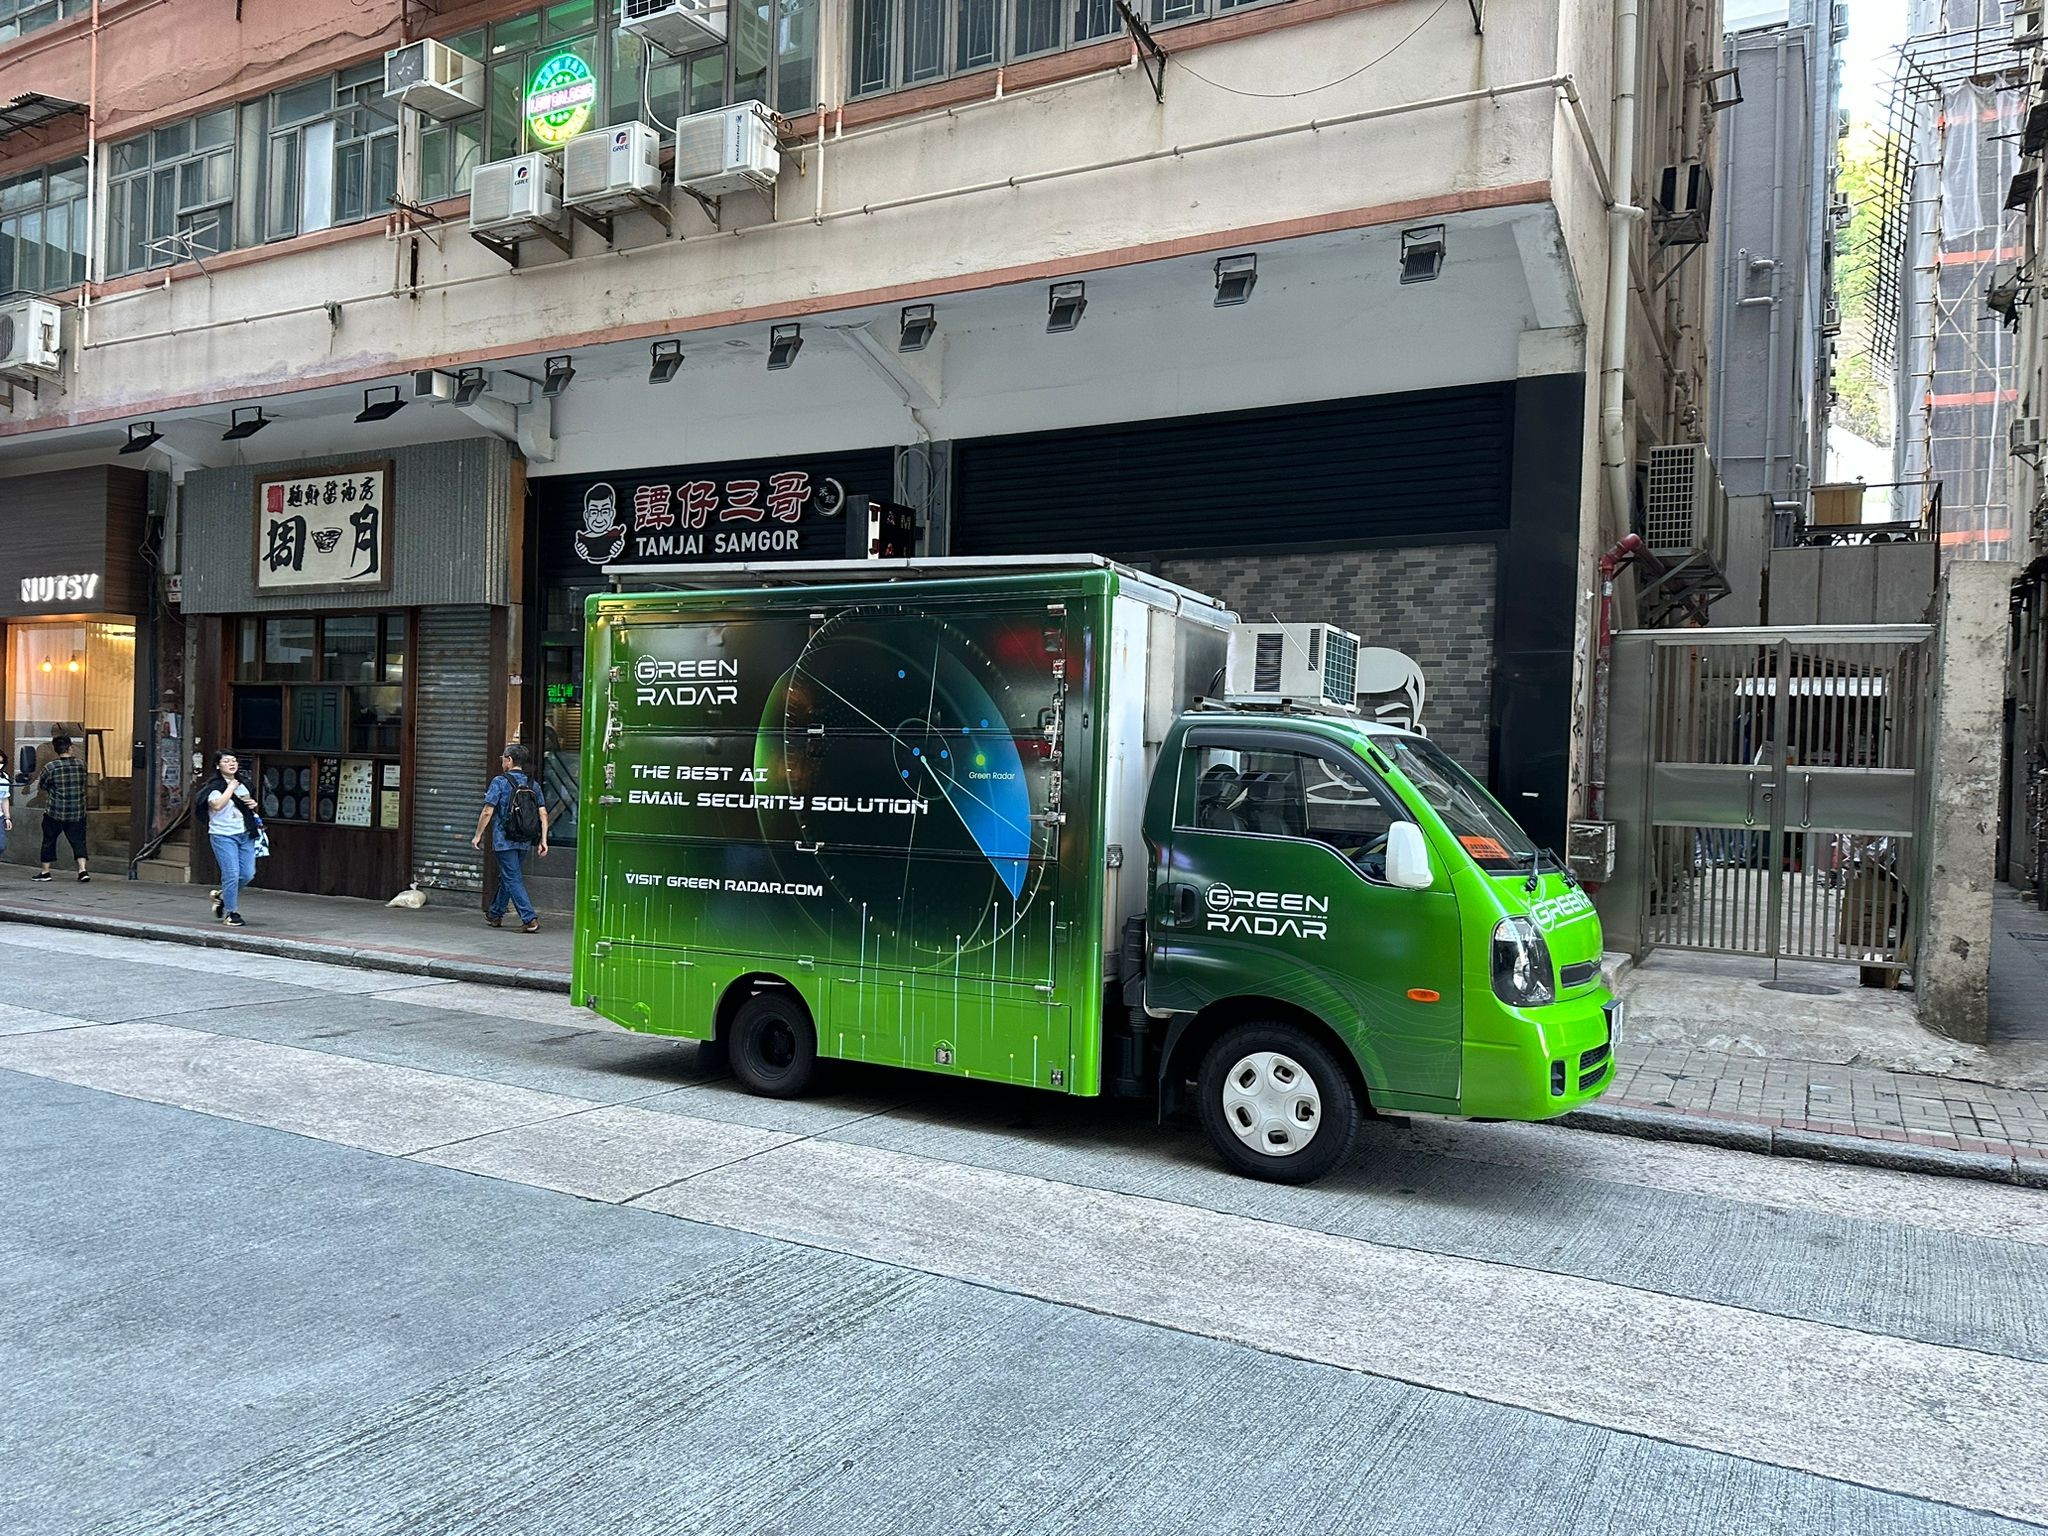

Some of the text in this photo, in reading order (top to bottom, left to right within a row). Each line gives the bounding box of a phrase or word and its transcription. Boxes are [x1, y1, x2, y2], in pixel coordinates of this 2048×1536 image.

[633, 471, 811, 531] 譚仔三哥
[262, 515, 306, 572] 周
[635, 529, 799, 557] TAMJAI SAMGOR
[21, 573, 99, 602] NUTSY
[635, 657, 738, 682] GREEN
[636, 686, 738, 706] RADAR
[631, 764, 768, 783] THE BEST AI
[968, 771, 1016, 780] Green Radar
[628, 790, 929, 815] EMAIL SECURITY SOLUTION
[625, 872, 823, 897] VISIT GREEN RADAR.COM
[1206, 884, 1329, 913] GREEN
[1206, 913, 1328, 940] RADAR
